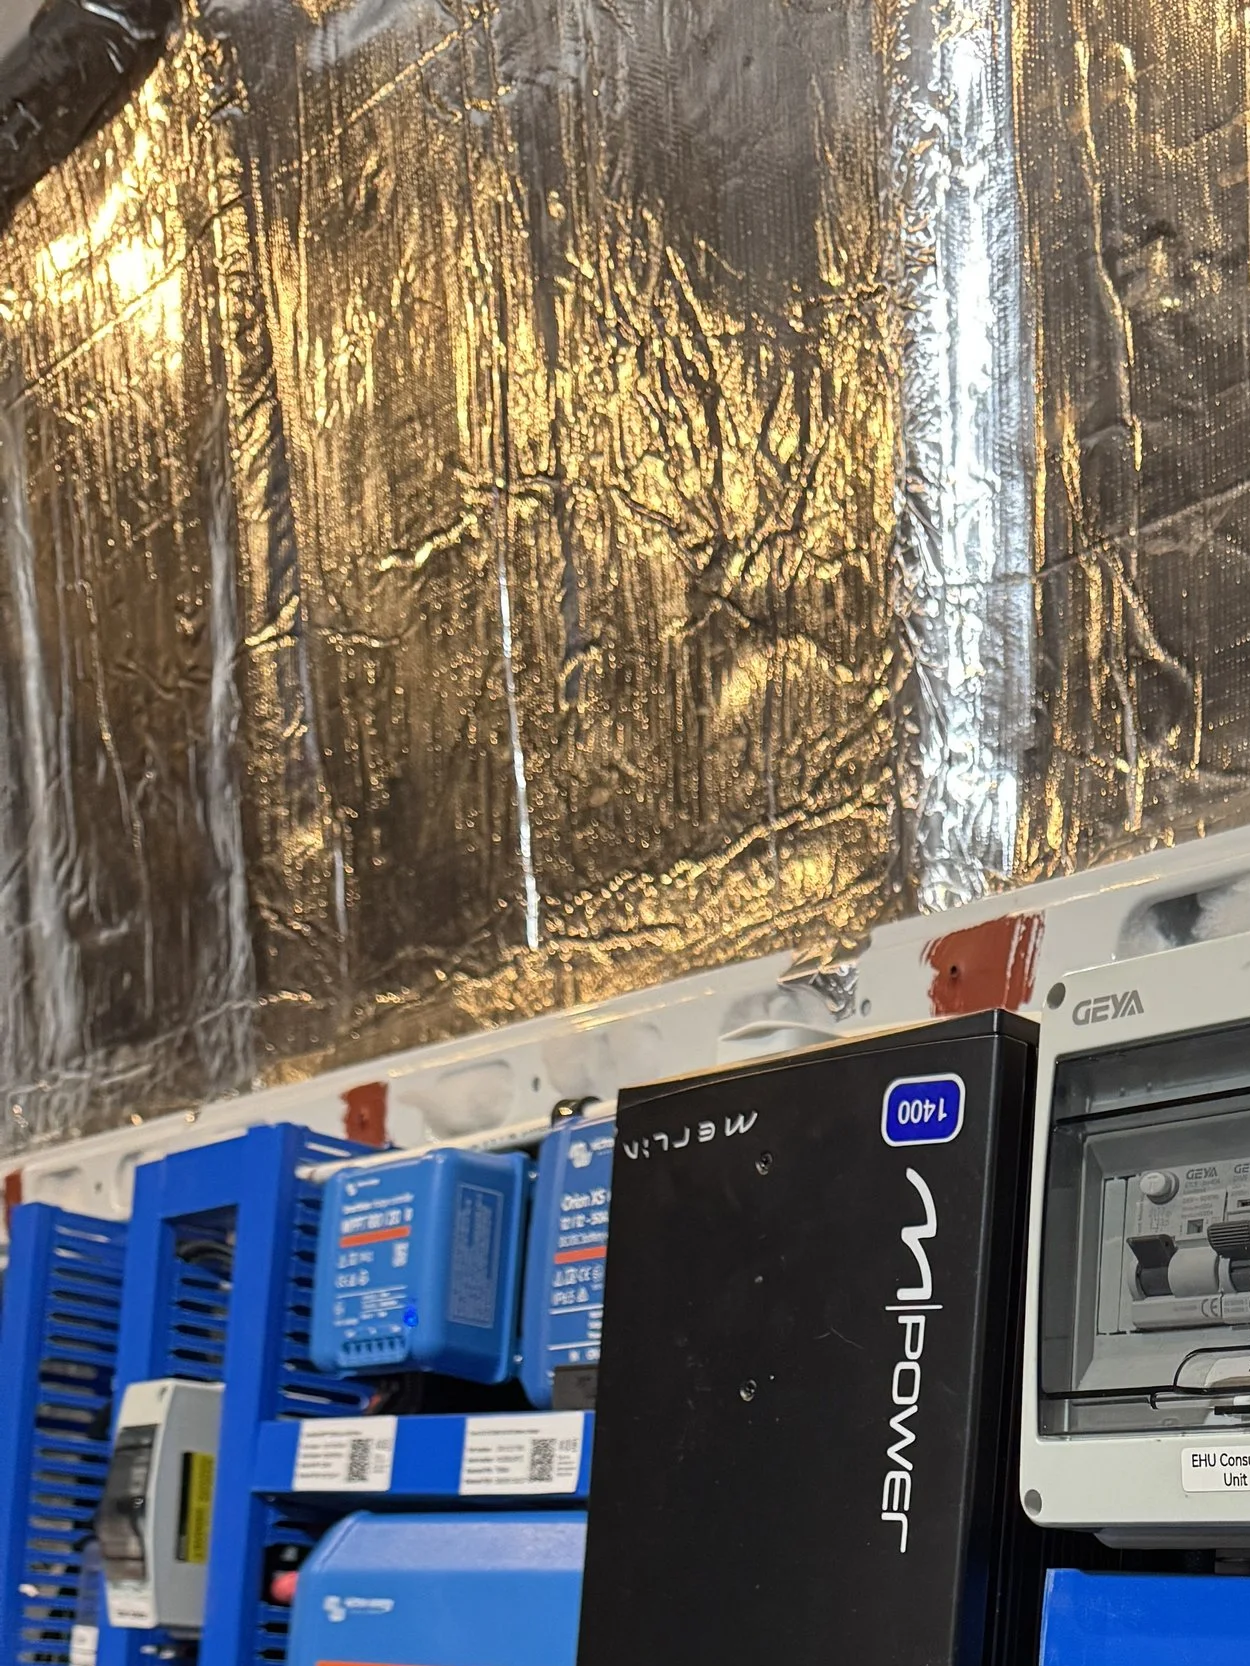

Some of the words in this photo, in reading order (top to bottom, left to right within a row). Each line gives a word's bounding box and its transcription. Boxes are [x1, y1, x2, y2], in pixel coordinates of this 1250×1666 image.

[1072, 990, 1144, 1025] GEYA
[898, 1099, 946, 1126] 1400
[1186, 1167, 1218, 1180] GEYA
[1191, 1454, 1217, 1470] EHU
[1223, 1472, 1248, 1487] Unit
